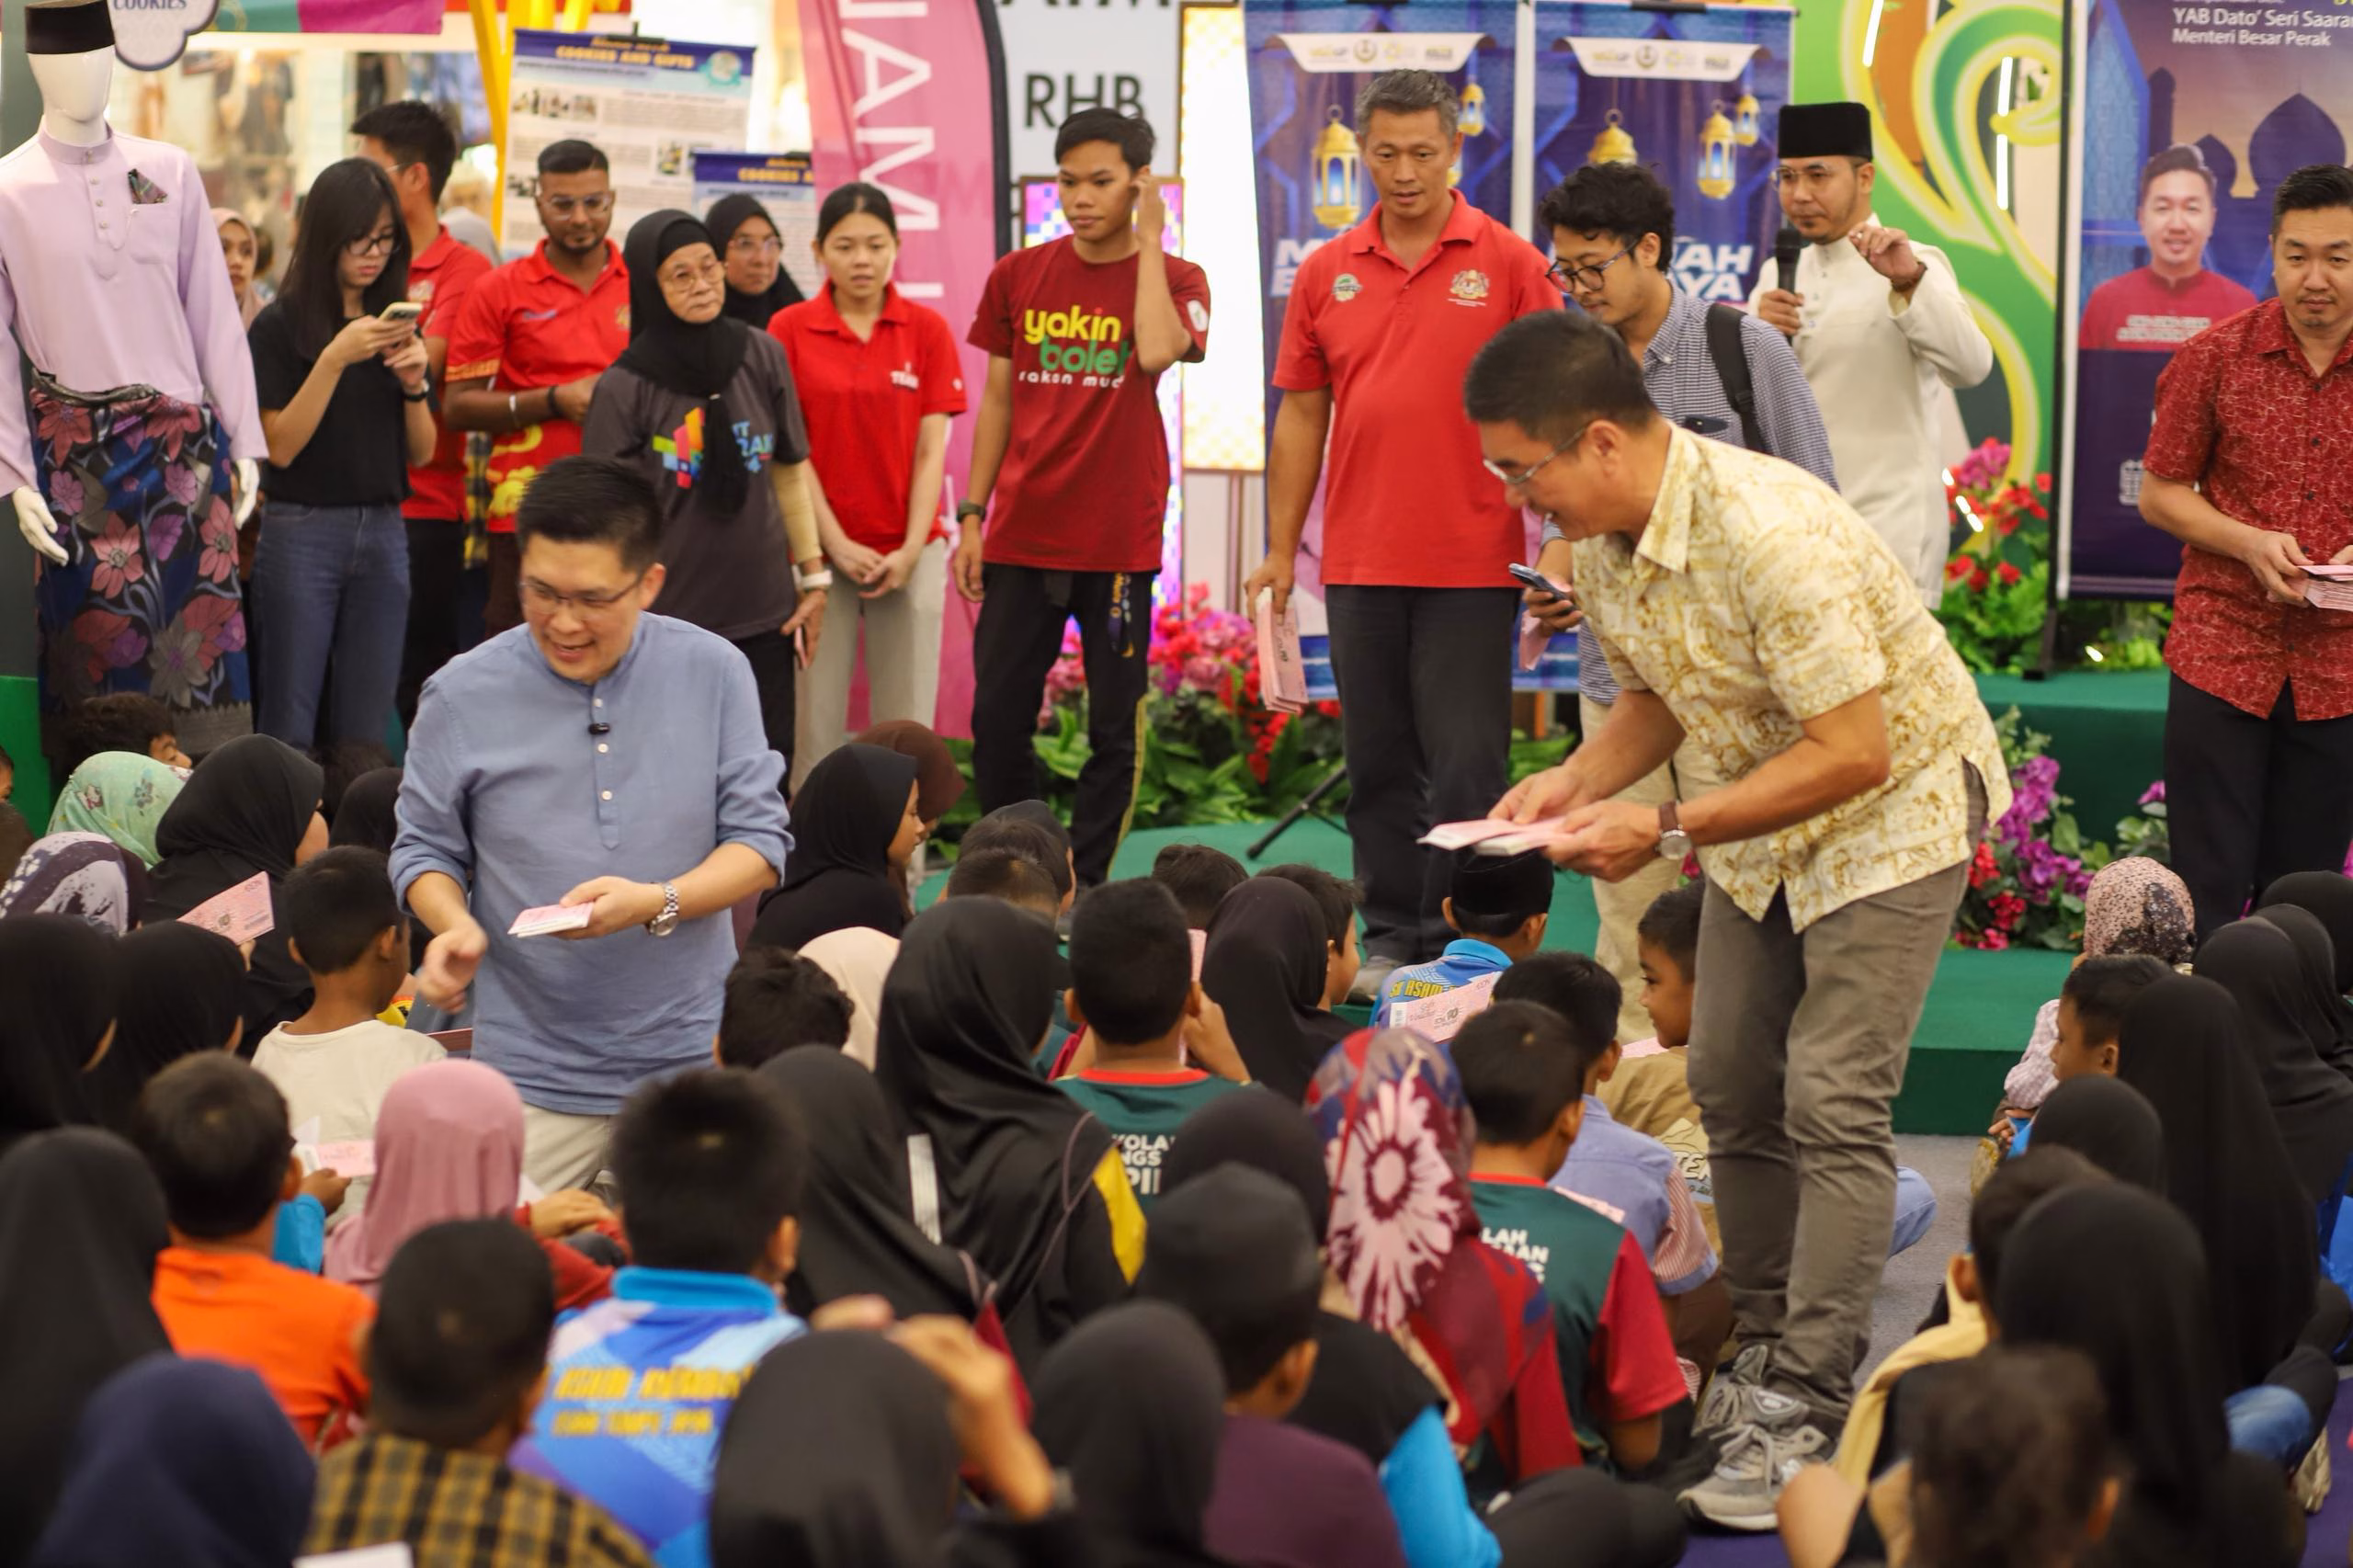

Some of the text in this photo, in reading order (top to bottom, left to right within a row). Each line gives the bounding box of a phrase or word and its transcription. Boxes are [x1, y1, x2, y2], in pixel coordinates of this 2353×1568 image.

[2173, 7, 2211, 25] YAB
[2265, 9, 2300, 27] Seri
[2172, 28, 2332, 46] Menteri Besar Perak
[1024, 73, 1147, 128] RHB
[1024, 304, 1121, 345] yakin
[1481, 1226, 1528, 1244] LAH
